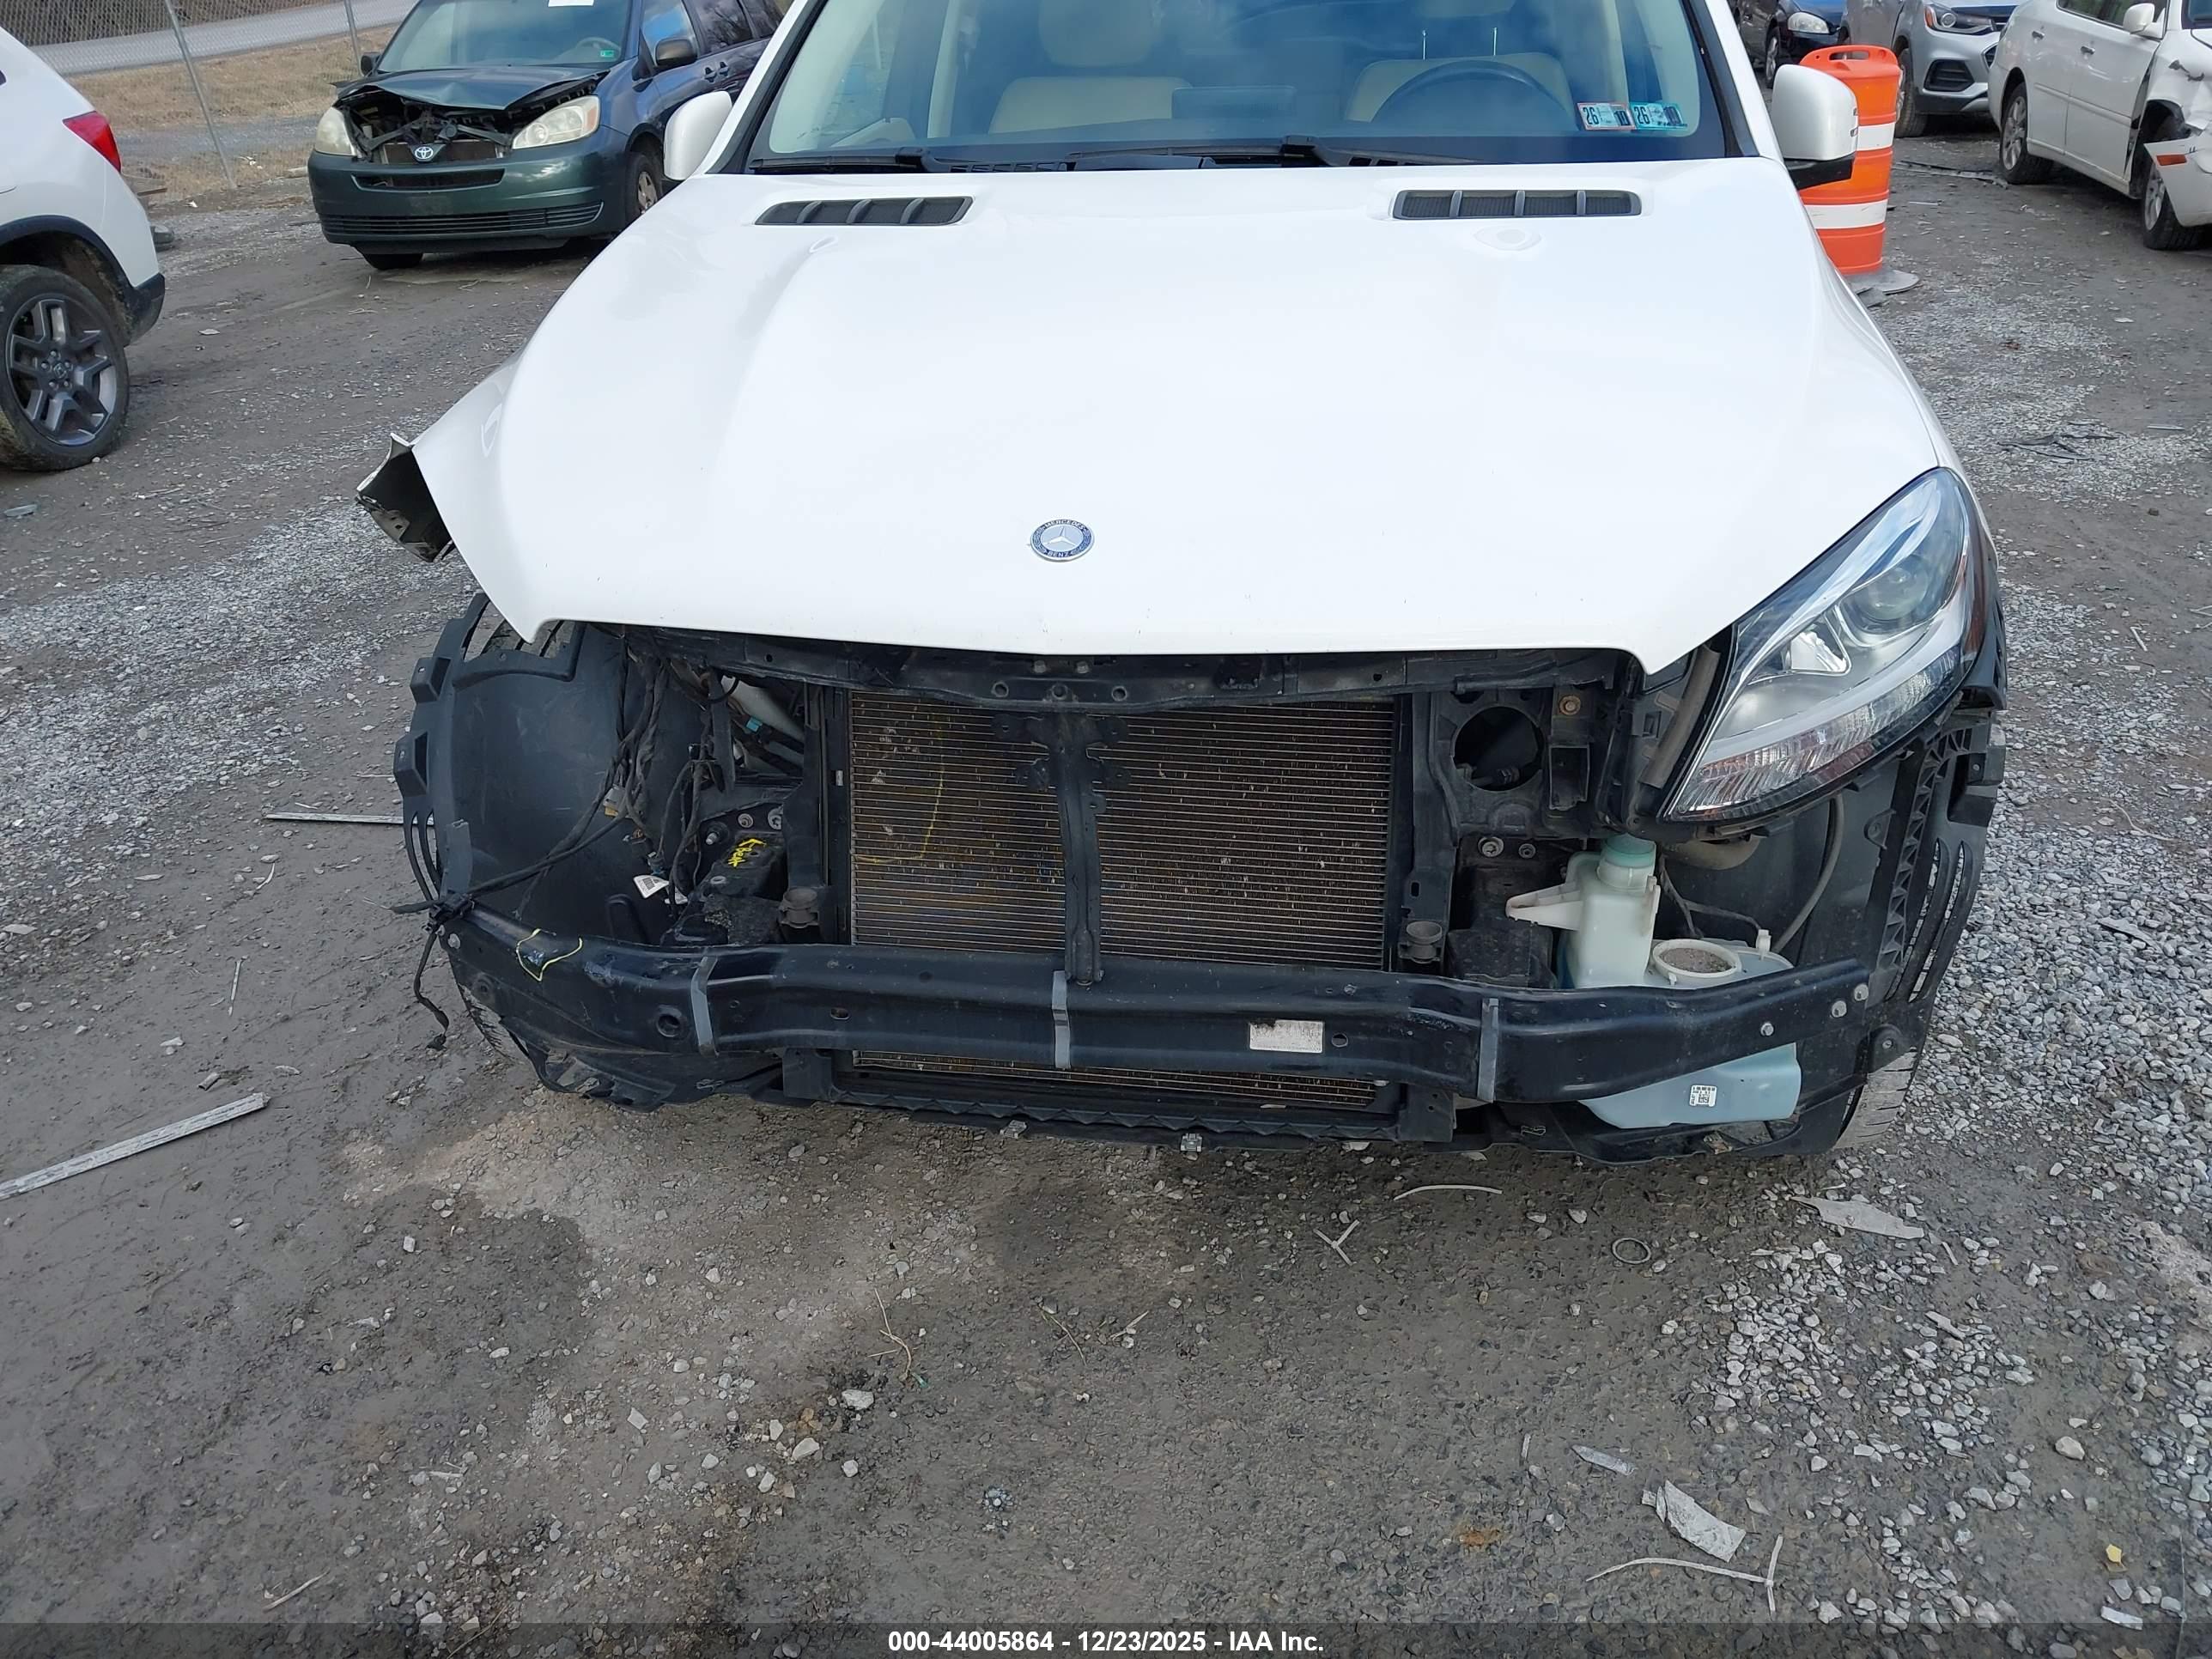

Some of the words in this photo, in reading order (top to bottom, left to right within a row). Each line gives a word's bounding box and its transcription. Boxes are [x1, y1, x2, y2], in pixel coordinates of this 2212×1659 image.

[1583, 106, 1599, 125] 26
[1633, 106, 1650, 125] 26
[1045, 519, 1085, 530] MERCEDES
